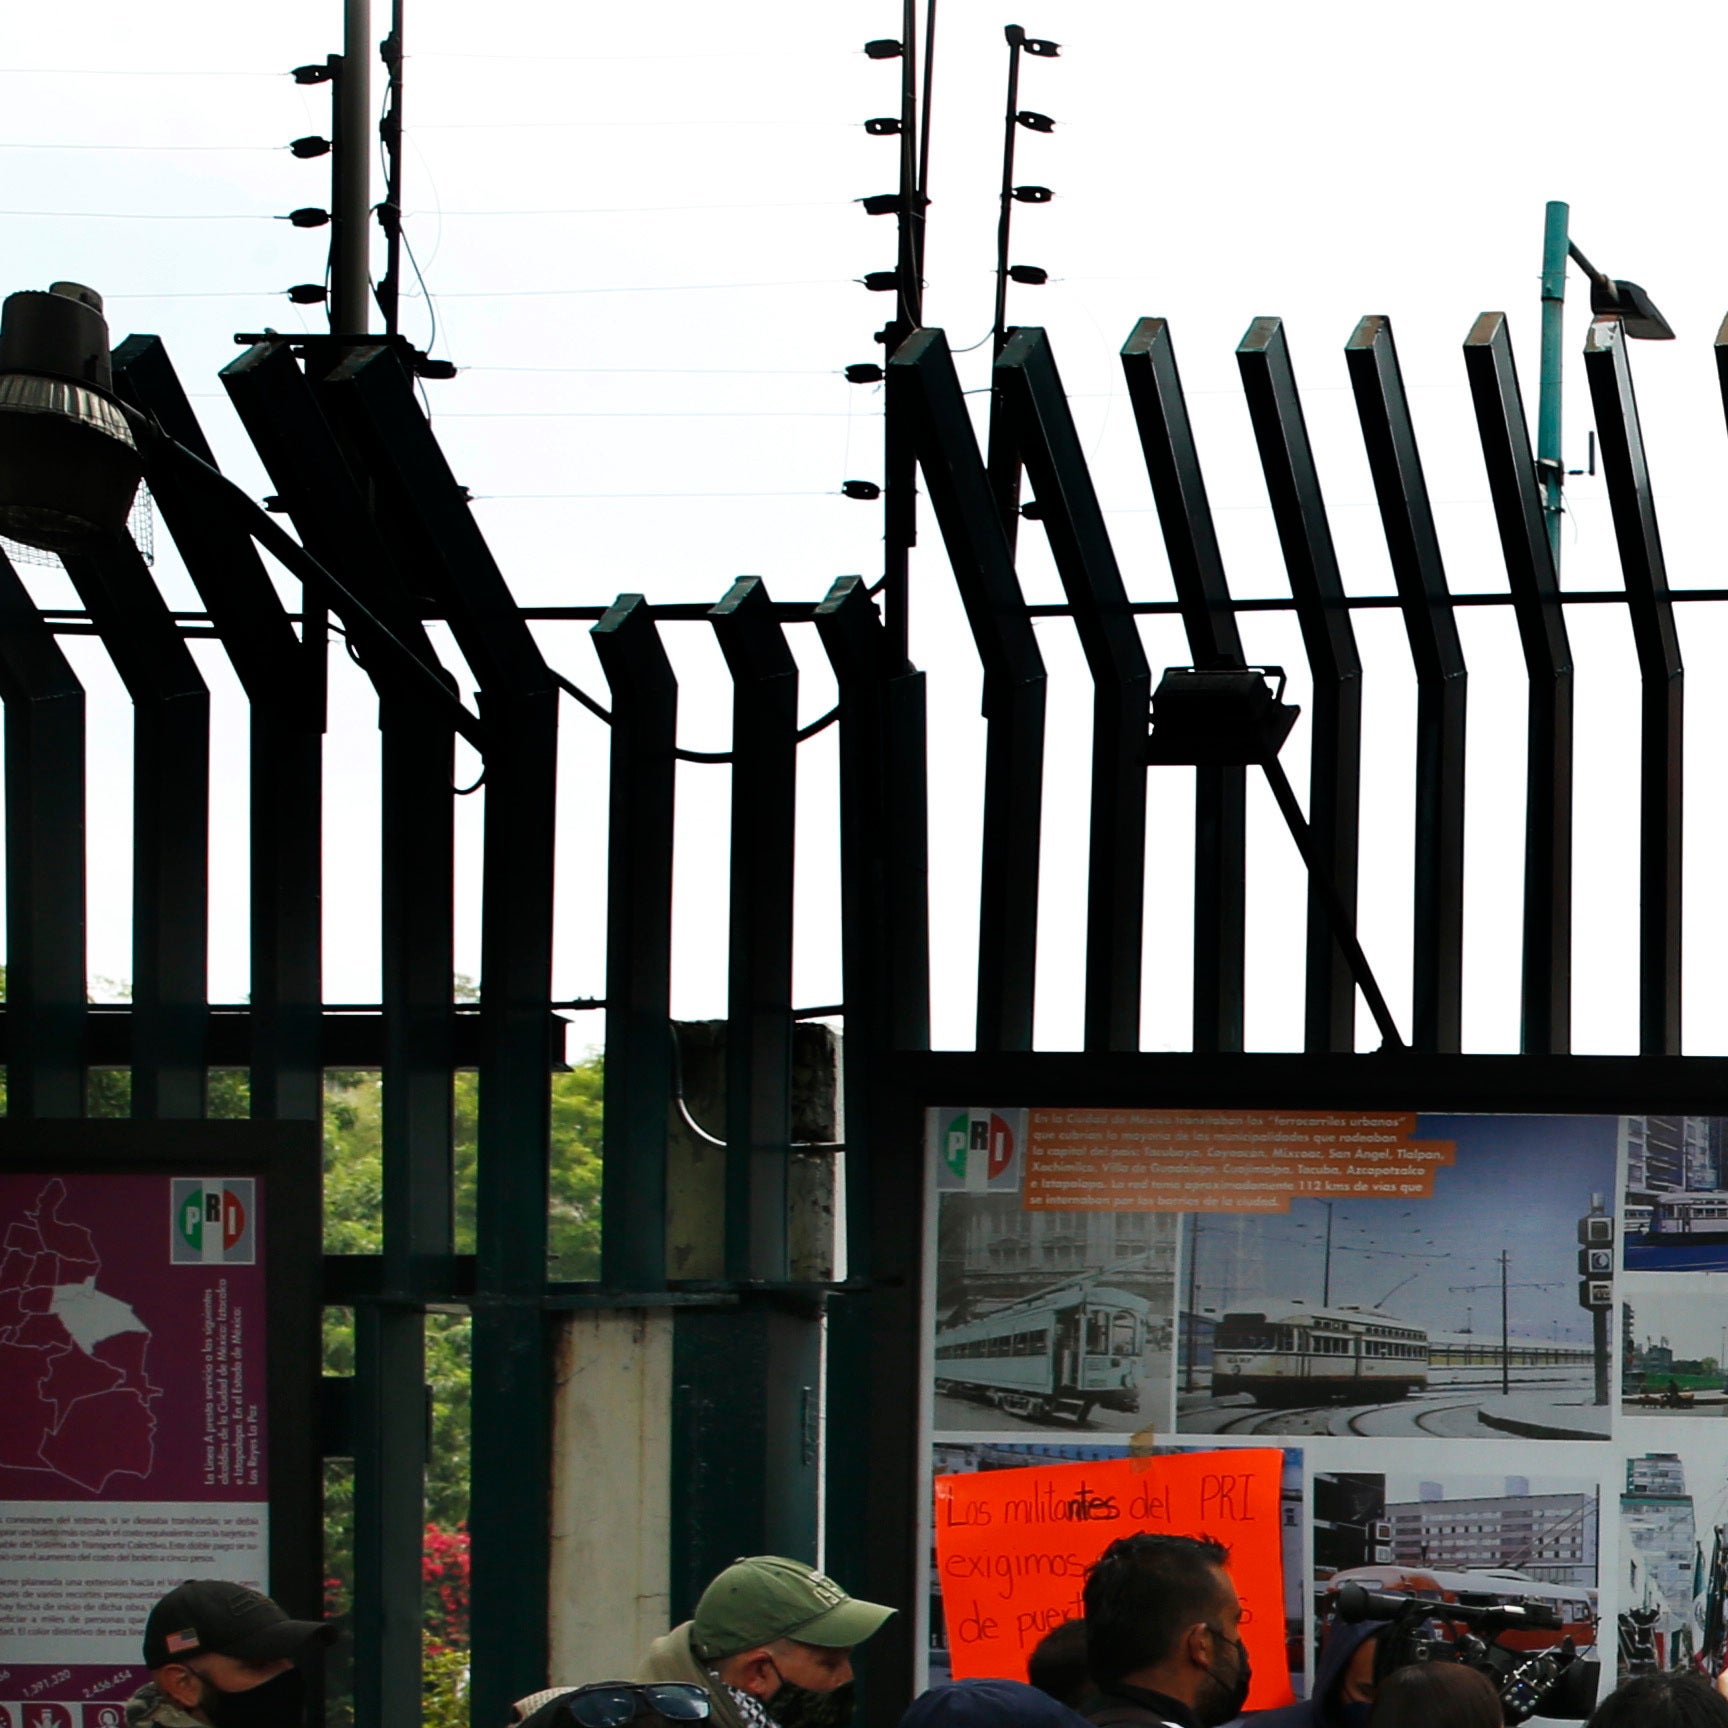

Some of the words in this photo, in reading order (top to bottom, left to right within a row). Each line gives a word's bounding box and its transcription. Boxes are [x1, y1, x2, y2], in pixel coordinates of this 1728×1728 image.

[948, 1121, 1004, 1163] PRI
[185, 1193, 238, 1236] PRI
[1129, 1480, 1171, 1524] del
[1201, 1474, 1255, 1521] PRI
[959, 1601, 998, 1643] de
